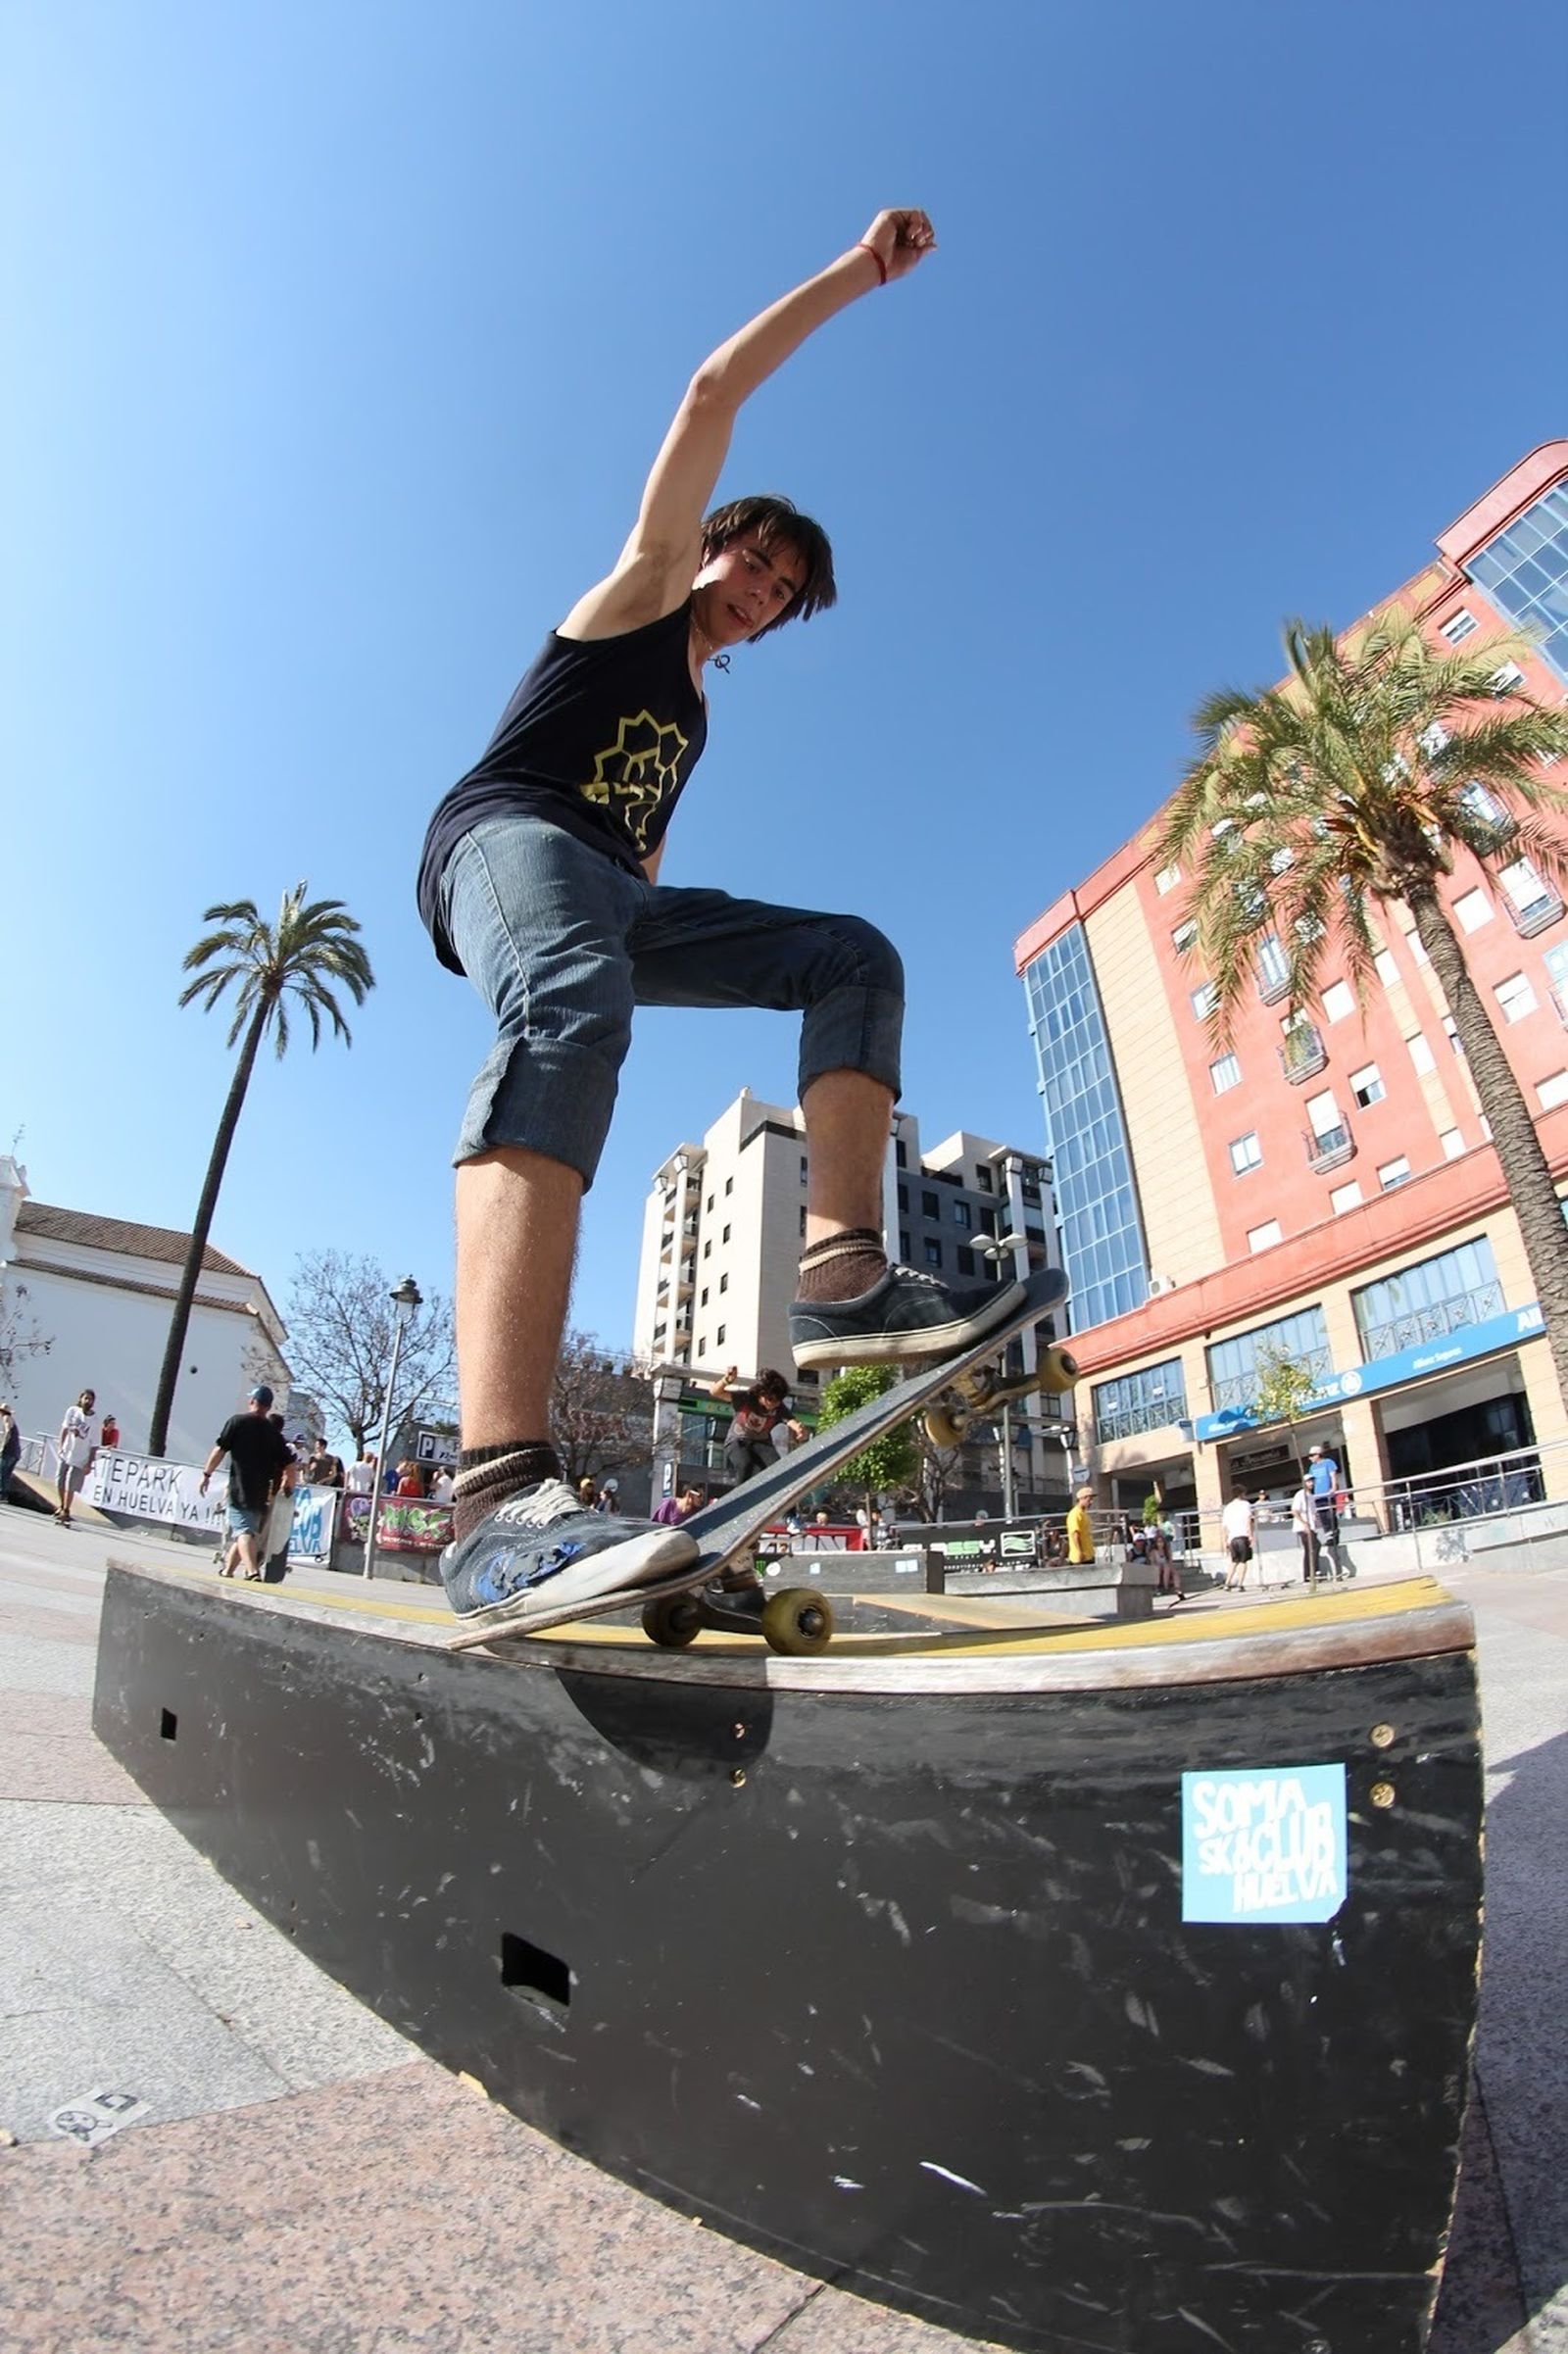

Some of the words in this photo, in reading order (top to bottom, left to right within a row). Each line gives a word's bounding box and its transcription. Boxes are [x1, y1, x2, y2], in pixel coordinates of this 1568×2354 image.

[94, 1485, 112, 1503] EN
[118, 1489, 173, 1515] HUELVA
[181, 1501, 198, 1521] YA
[1192, 1778, 1307, 1839] SOMA
[1233, 1864, 1338, 1914] HUELVA
